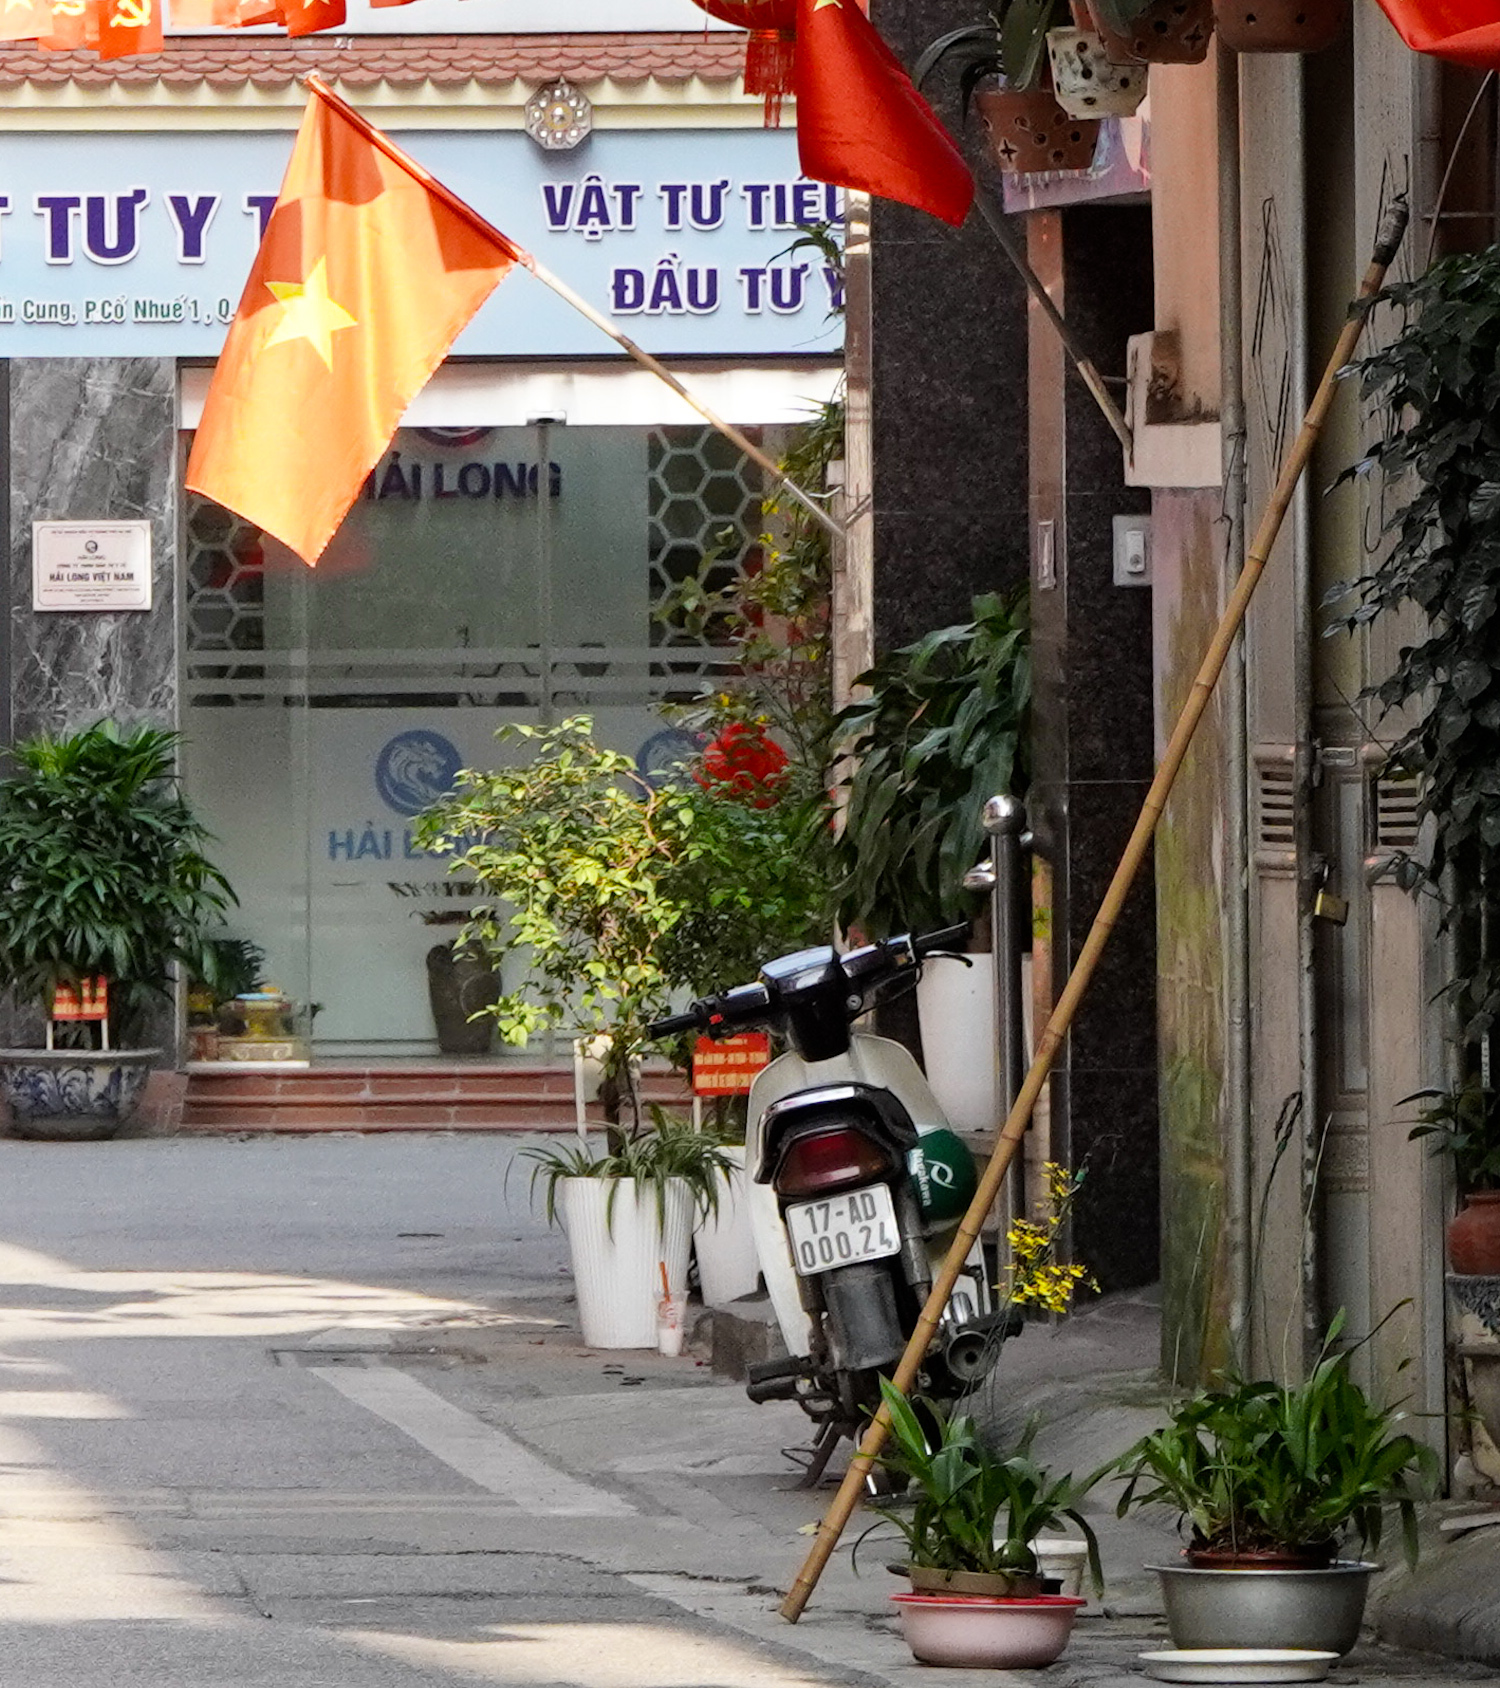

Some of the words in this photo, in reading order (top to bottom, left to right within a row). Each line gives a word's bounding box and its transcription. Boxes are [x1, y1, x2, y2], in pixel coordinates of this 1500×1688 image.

[37, 188, 148, 261] TƯ
[167, 195, 219, 261] Y
[542, 175, 641, 238] VẬT
[660, 179, 731, 227] TƯ
[612, 252, 720, 311] ĐẦU
[739, 263, 811, 311] TƯ
[22, 299, 78, 326] Cung,
[133, 293, 187, 324] Nhuế
[435, 461, 562, 500] LONG
[328, 820, 393, 861] HẢI
[804, 1193, 877, 1235] 17-AD
[800, 1221, 893, 1269] 000.24
